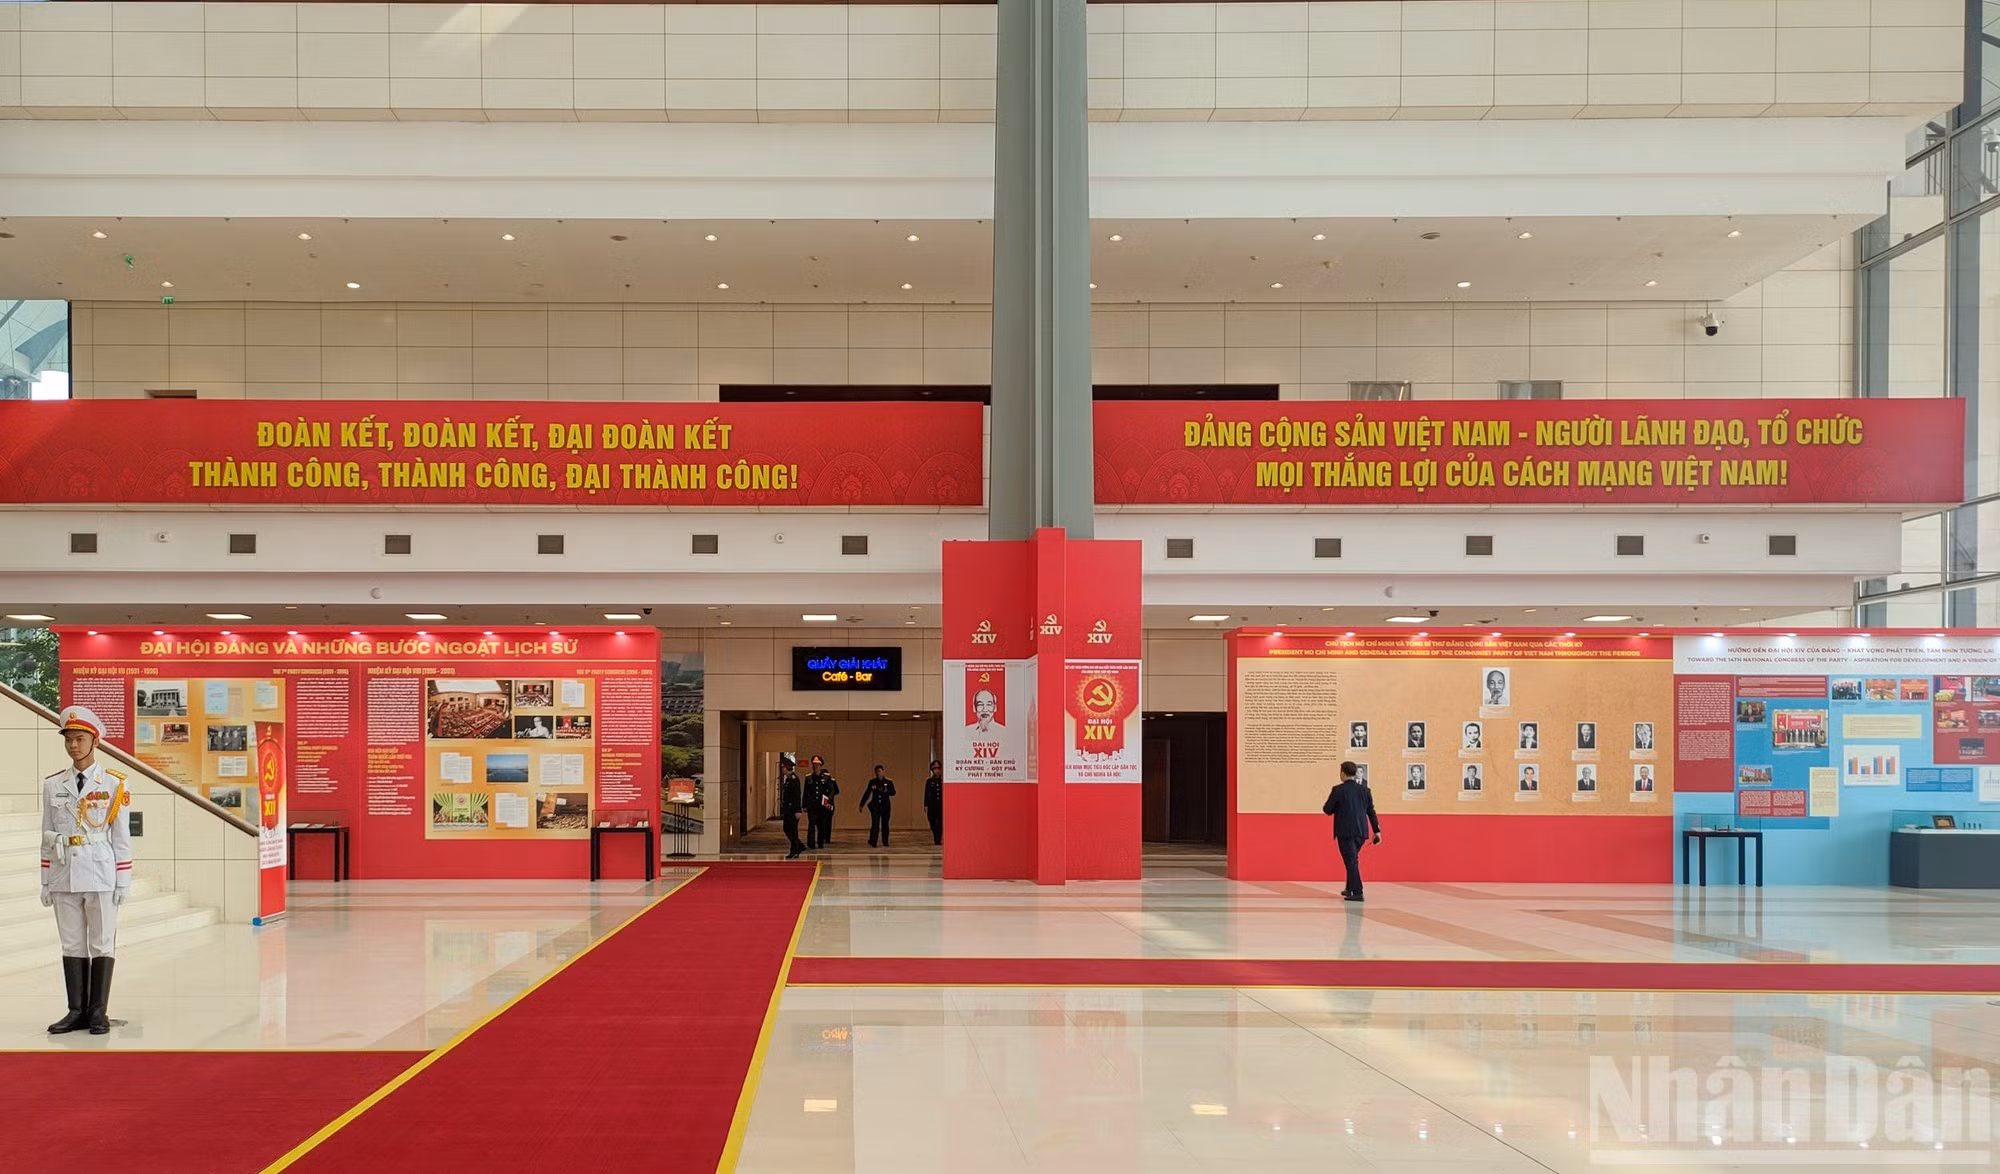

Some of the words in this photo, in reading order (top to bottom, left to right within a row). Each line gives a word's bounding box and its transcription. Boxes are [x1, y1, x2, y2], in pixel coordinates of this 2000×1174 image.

[257, 417, 331, 448] ĐOÀN
[341, 414, 393, 450] KẾT,
[403, 417, 477, 448] ĐOÀN
[487, 415, 538, 451] KẾT,
[549, 423, 593, 454] ĐẠI
[602, 418, 674, 449] ĐOÀN
[684, 416, 732, 449] KẾT
[1184, 413, 1252, 447] ĐẢNG
[1260, 417, 1327, 452] CỘNG
[1335, 413, 1386, 447] SẢN
[1392, 416, 1445, 452] VIỆT
[1452, 420, 1510, 446] NAM
[1536, 414, 1612, 446] NGƯỜI
[1621, 415, 1685, 445] LÃNH
[1693, 419, 1750, 450] ĐẠO,
[1758, 409, 1789, 445] TỔ
[1796, 414, 1863, 445] CHỨC
[189, 457, 277, 487] THÀNH
[288, 457, 369, 490] CÔNG,
[379, 457, 465, 488] THÀNH
[476, 458, 556, 491] CÔNG,
[566, 463, 610, 494] ĐẠI
[620, 458, 706, 489] THÀNH
[717, 459, 798, 490] CÔNG!
[1256, 462, 1303, 492] MỌI
[1311, 452, 1392, 486] THẮNG
[1400, 458, 1437, 492] LỢI
[1445, 453, 1495, 486] CỦA
[1503, 456, 1569, 486] CÁCH
[1577, 460, 1652, 492] MẠNG
[1660, 455, 1712, 491] VIỆT
[1720, 460, 1787, 486] NAM!
[1040, 625, 1063, 635] XIV
[971, 633, 997, 644] XIV
[1087, 633, 1113, 644] XIV
[140, 641, 172, 656] ĐẠI
[176, 639, 210, 656] HỘI
[214, 639, 269, 655] ĐẢNG
[272, 639, 299, 655] VÀ
[302, 639, 371, 655] NHỮNG
[376, 639, 431, 655] BƯỚC
[434, 640, 499, 657] NGOẶT
[503, 641, 547, 657] LỊCH
[551, 639, 578, 655] SỬ
[822, 671, 848, 681] Café
[855, 671, 873, 681] Bar
[1084, 725, 1116, 740] XIV
[973, 748, 999, 758] XIV
